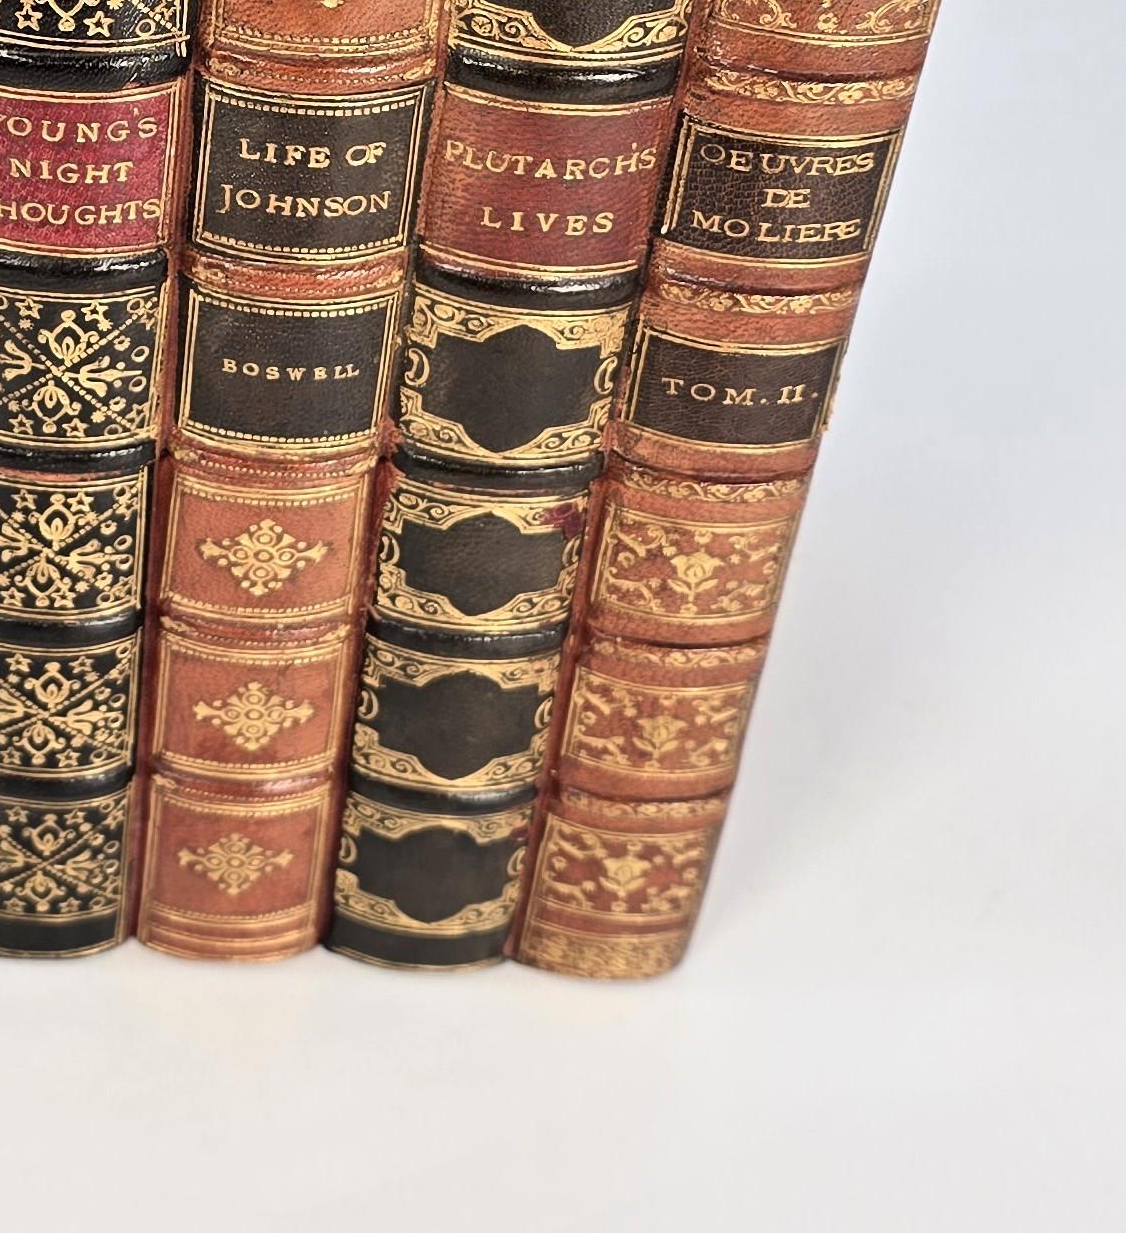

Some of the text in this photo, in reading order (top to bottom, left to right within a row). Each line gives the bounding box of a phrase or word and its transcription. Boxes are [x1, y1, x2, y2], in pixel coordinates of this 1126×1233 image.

[238, 138, 387, 169] LIFE OF
[444, 140, 657, 181] PLUTARCH'S
[699, 143, 874, 176] OEUVRES
[9, 157, 134, 185] NIGHT
[220, 184, 391, 219] JOHNSON
[761, 187, 810, 209] DE
[480, 206, 614, 236] LIVES
[691, 210, 861, 243] MOLIERE
[221, 358, 360, 382] BOSWELL
